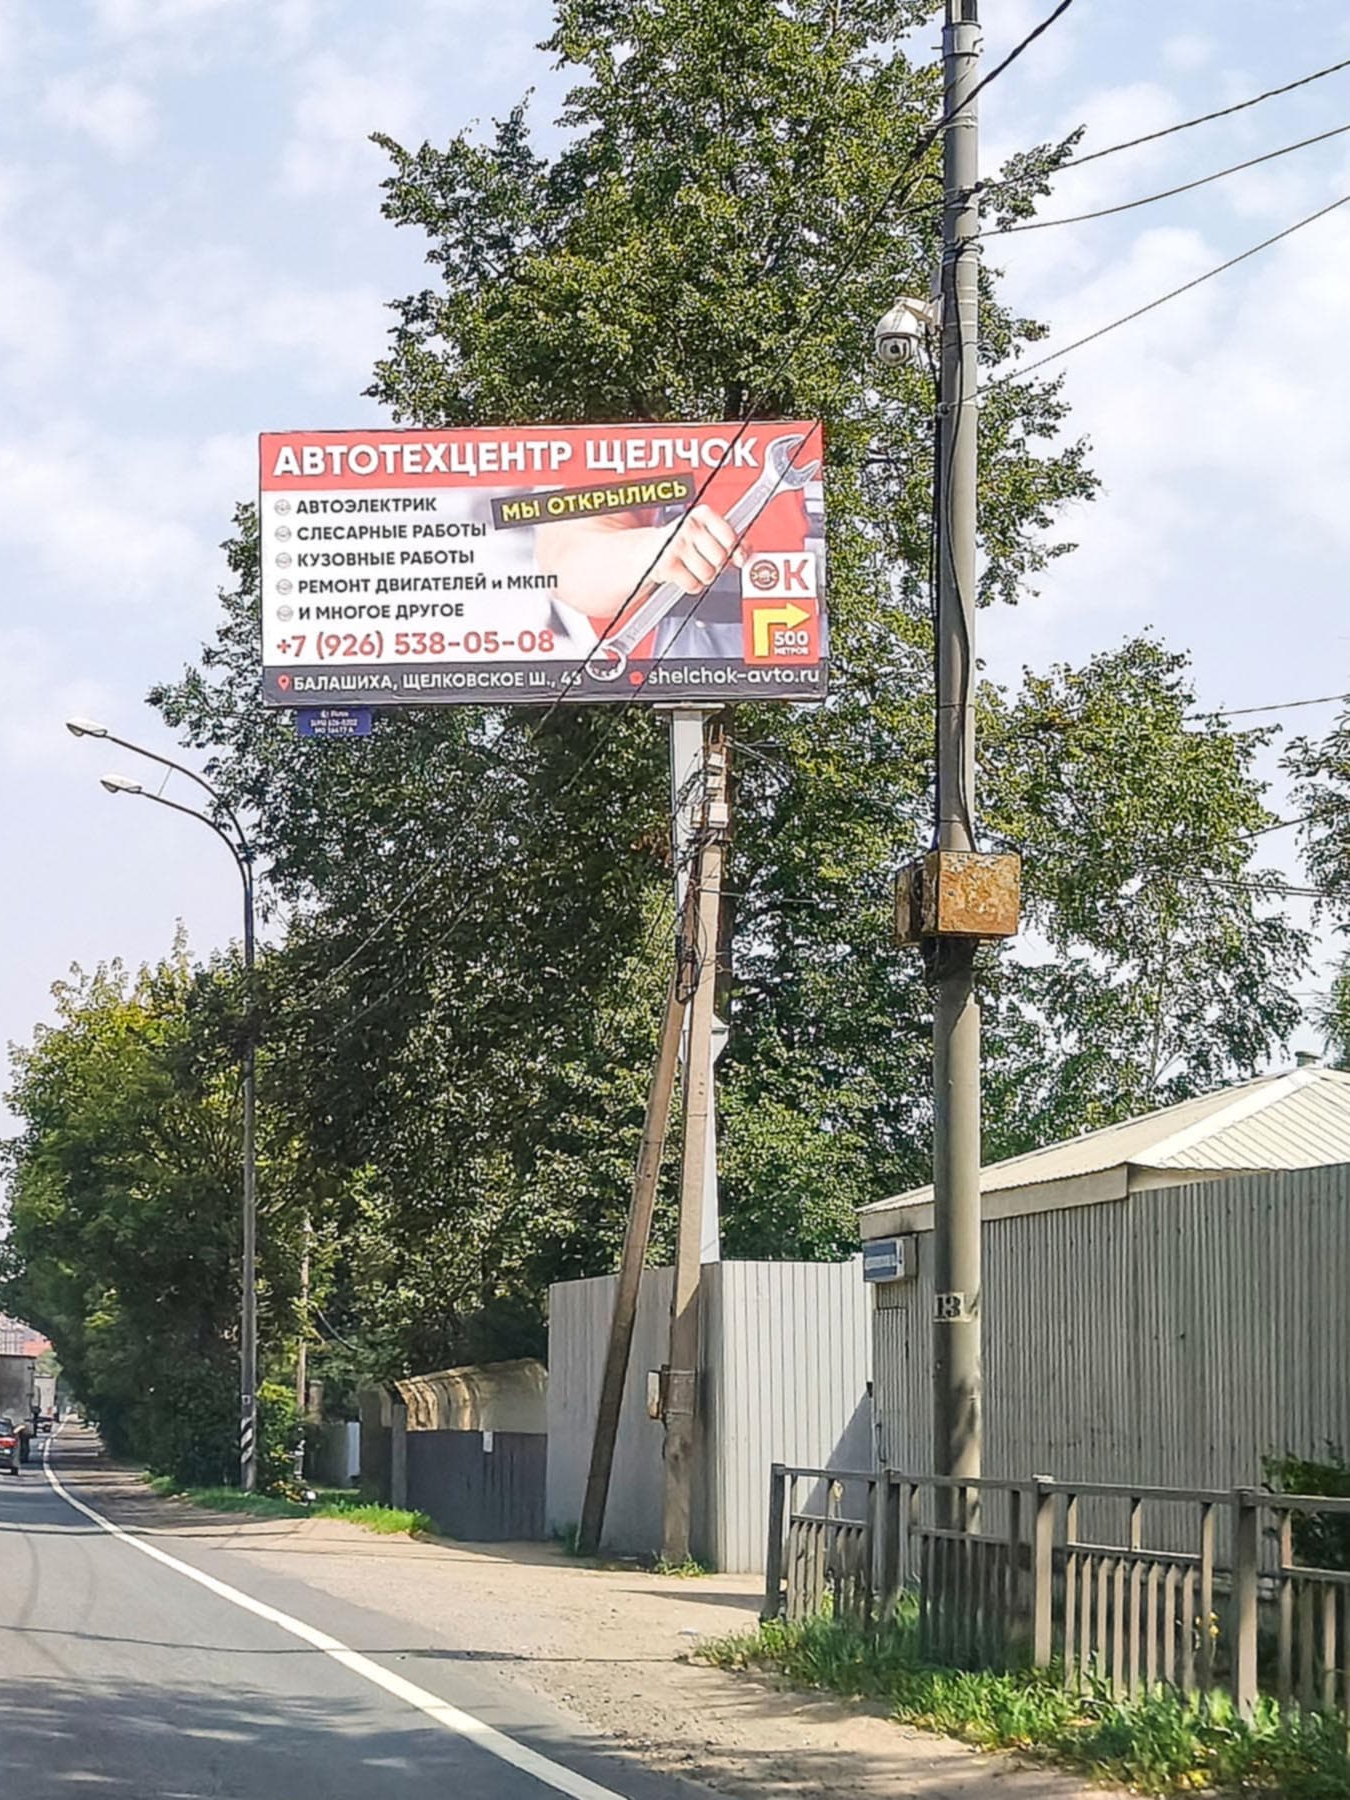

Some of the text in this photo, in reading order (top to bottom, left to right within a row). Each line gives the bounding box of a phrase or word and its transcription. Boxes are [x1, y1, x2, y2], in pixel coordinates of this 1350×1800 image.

[273, 437, 759, 477] АВТОТЕХЦЕНТР ЩЕЛЧОК
[296, 497, 437, 515] АВТОЭЛЕКТРИК
[501, 481, 687, 522] МЫ ОТКРЫЛИСЬ
[297, 523, 486, 541] СЛЕСАРНЫЕ РАБОТЫ
[298, 550, 474, 567] КУЗОВНЫЕ РАБОТЫ
[299, 578, 370, 594] РЕМОНТ
[375, 573, 486, 594] ДВИГАТЕЛЕЙ
[507, 574, 558, 589] МКПП
[299, 603, 464, 620] И МНОГОЕ ДРУГОЕ
[277, 630, 554, 660] +7 (926) 538-05-08
[774, 630, 809, 646] 500
[293, 675, 398, 692] БАЛАШИХА,
[403, 672, 524, 690] ЩЕЛКОВСКОЕ
[648, 666, 819, 685] shelchok-avto.ru
[934, 1296, 961, 1319] 13
